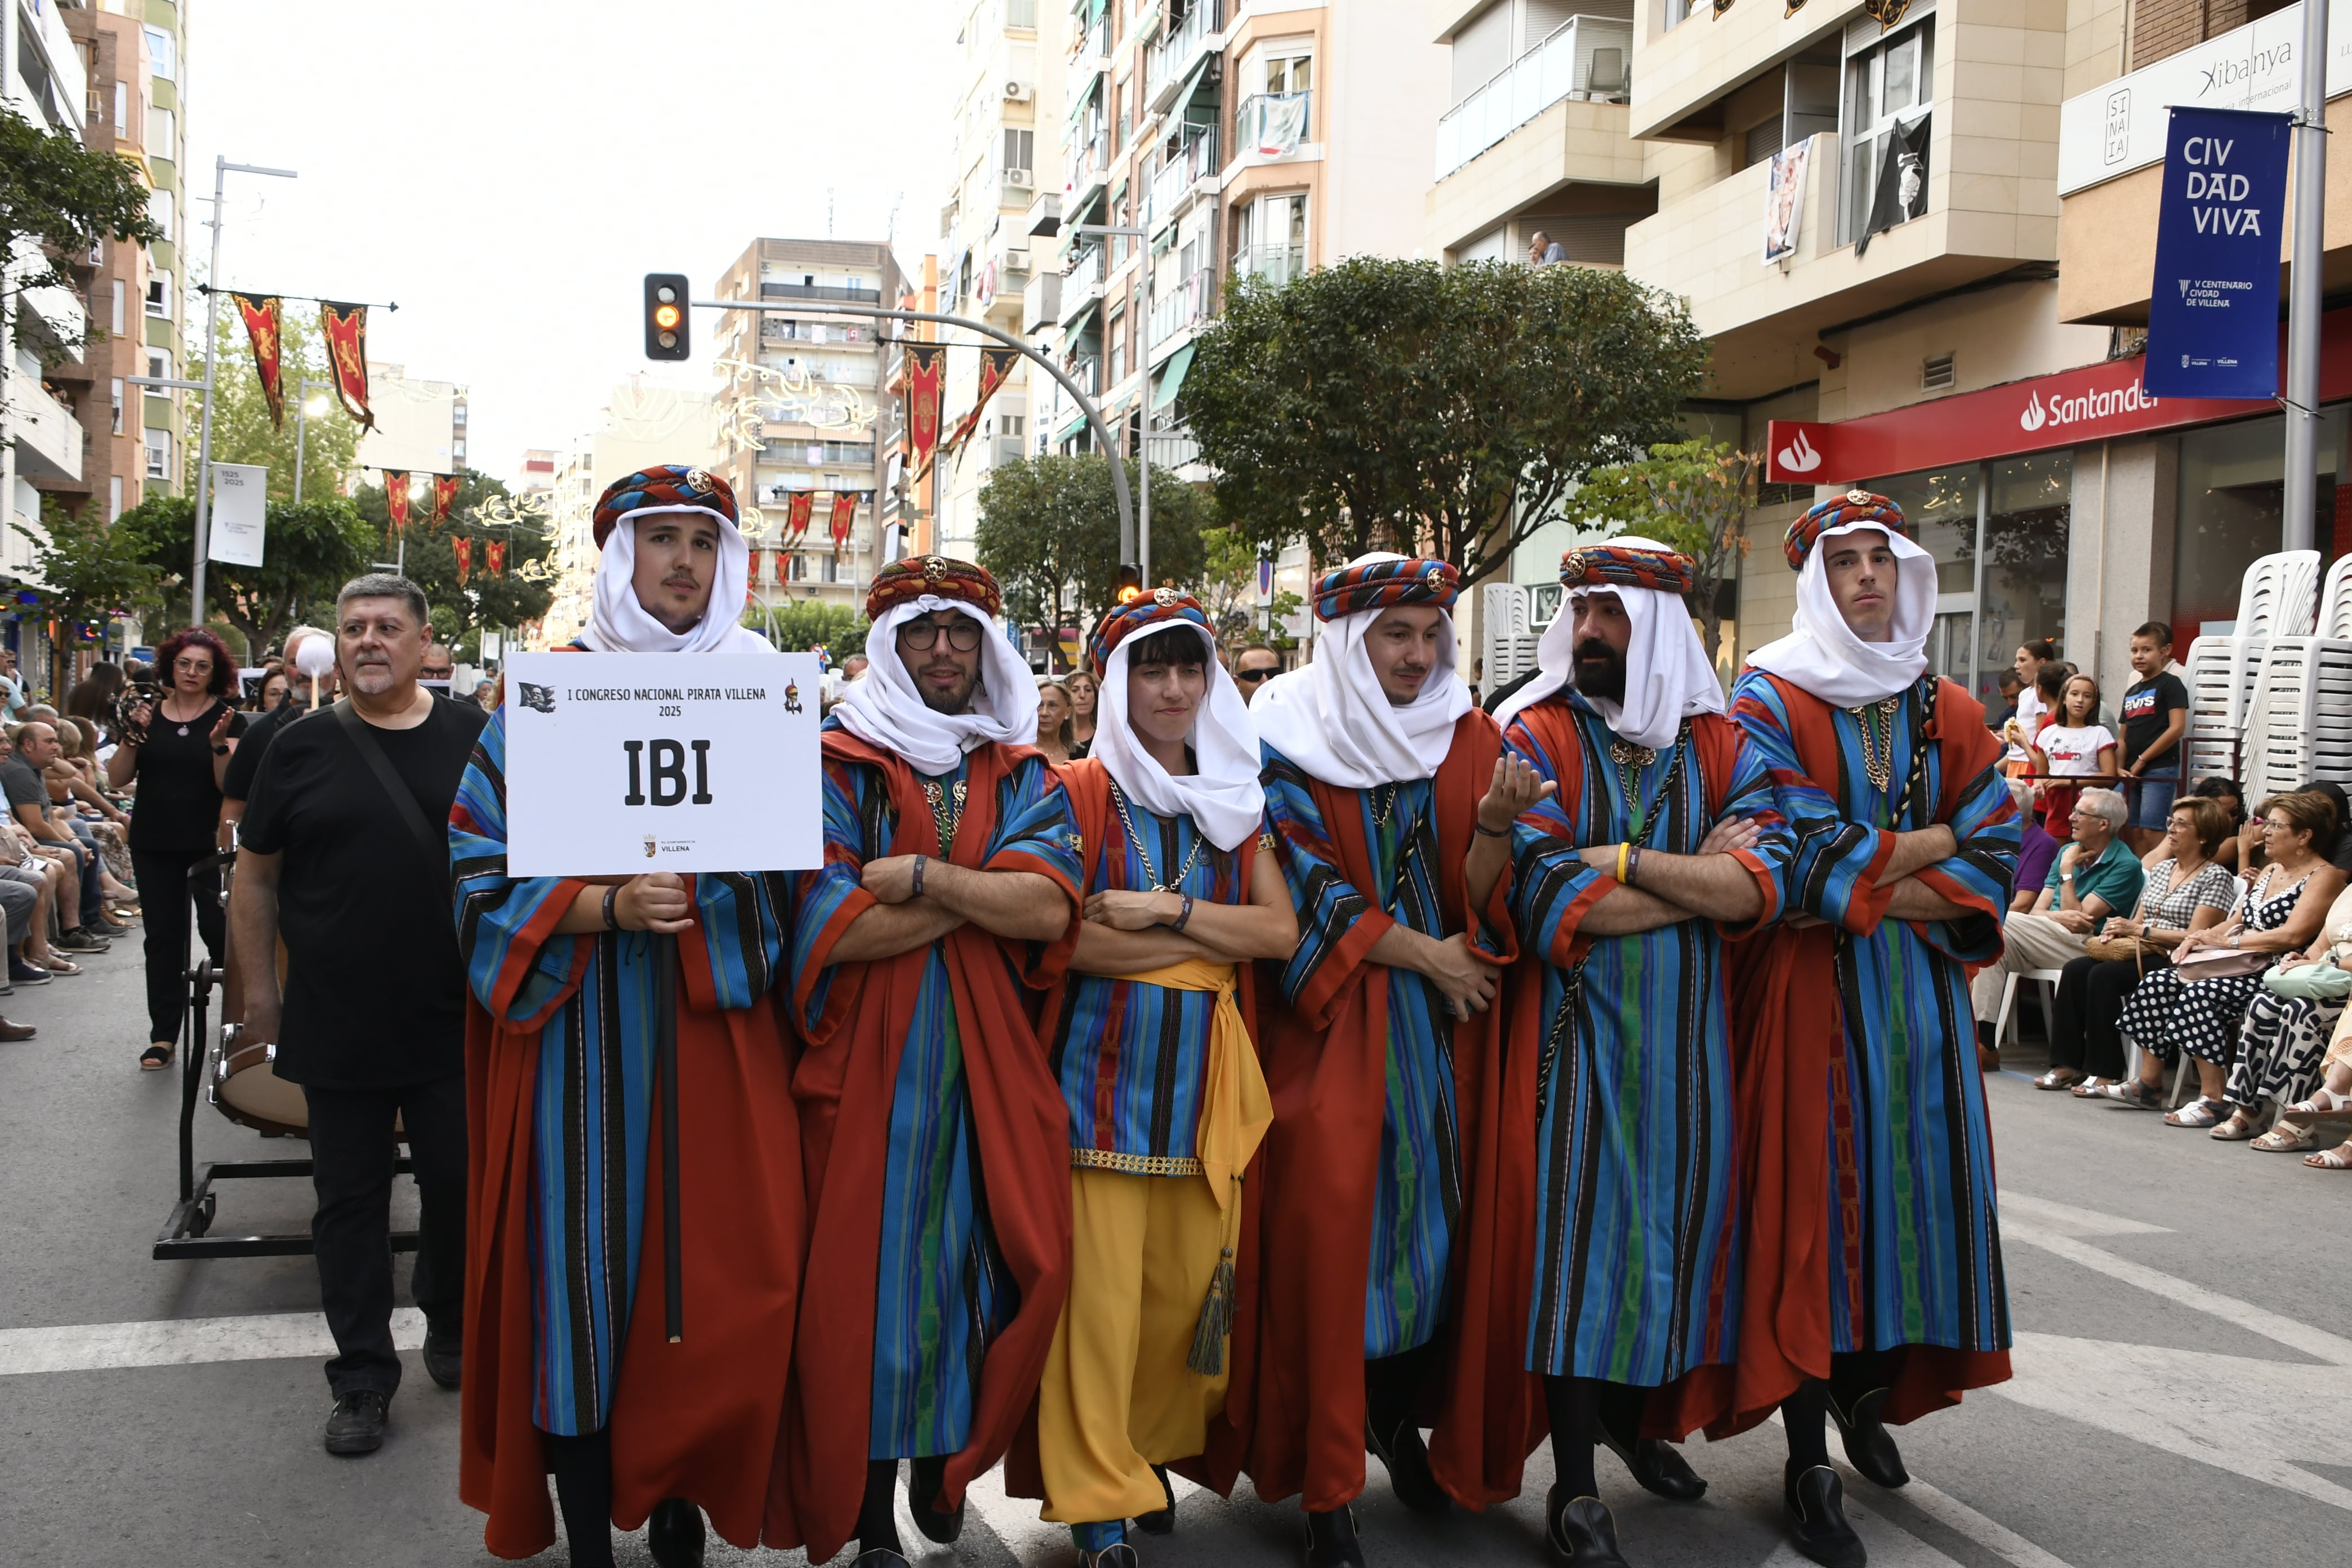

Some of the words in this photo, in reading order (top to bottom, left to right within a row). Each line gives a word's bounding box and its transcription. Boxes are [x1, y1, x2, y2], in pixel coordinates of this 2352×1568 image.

[2238, 77, 2292, 108] internacional
[2184, 136, 2234, 166] CIV
[2186, 171, 2249, 202] DAD
[2193, 206, 2261, 237] VIVA
[2190, 289, 2219, 297] CIVDAD
[2202, 280, 2252, 289] CENTENARIO
[2186, 298, 2197, 306] DE
[568, 689, 572, 701] I
[575, 688, 631, 701] CONGRESO
[634, 688, 685, 701] NACIONAL
[687, 688, 721, 701] PIRATA
[724, 688, 766, 700] VILLENA
[659, 705, 681, 717] 2025
[623, 738, 713, 807] IBI
